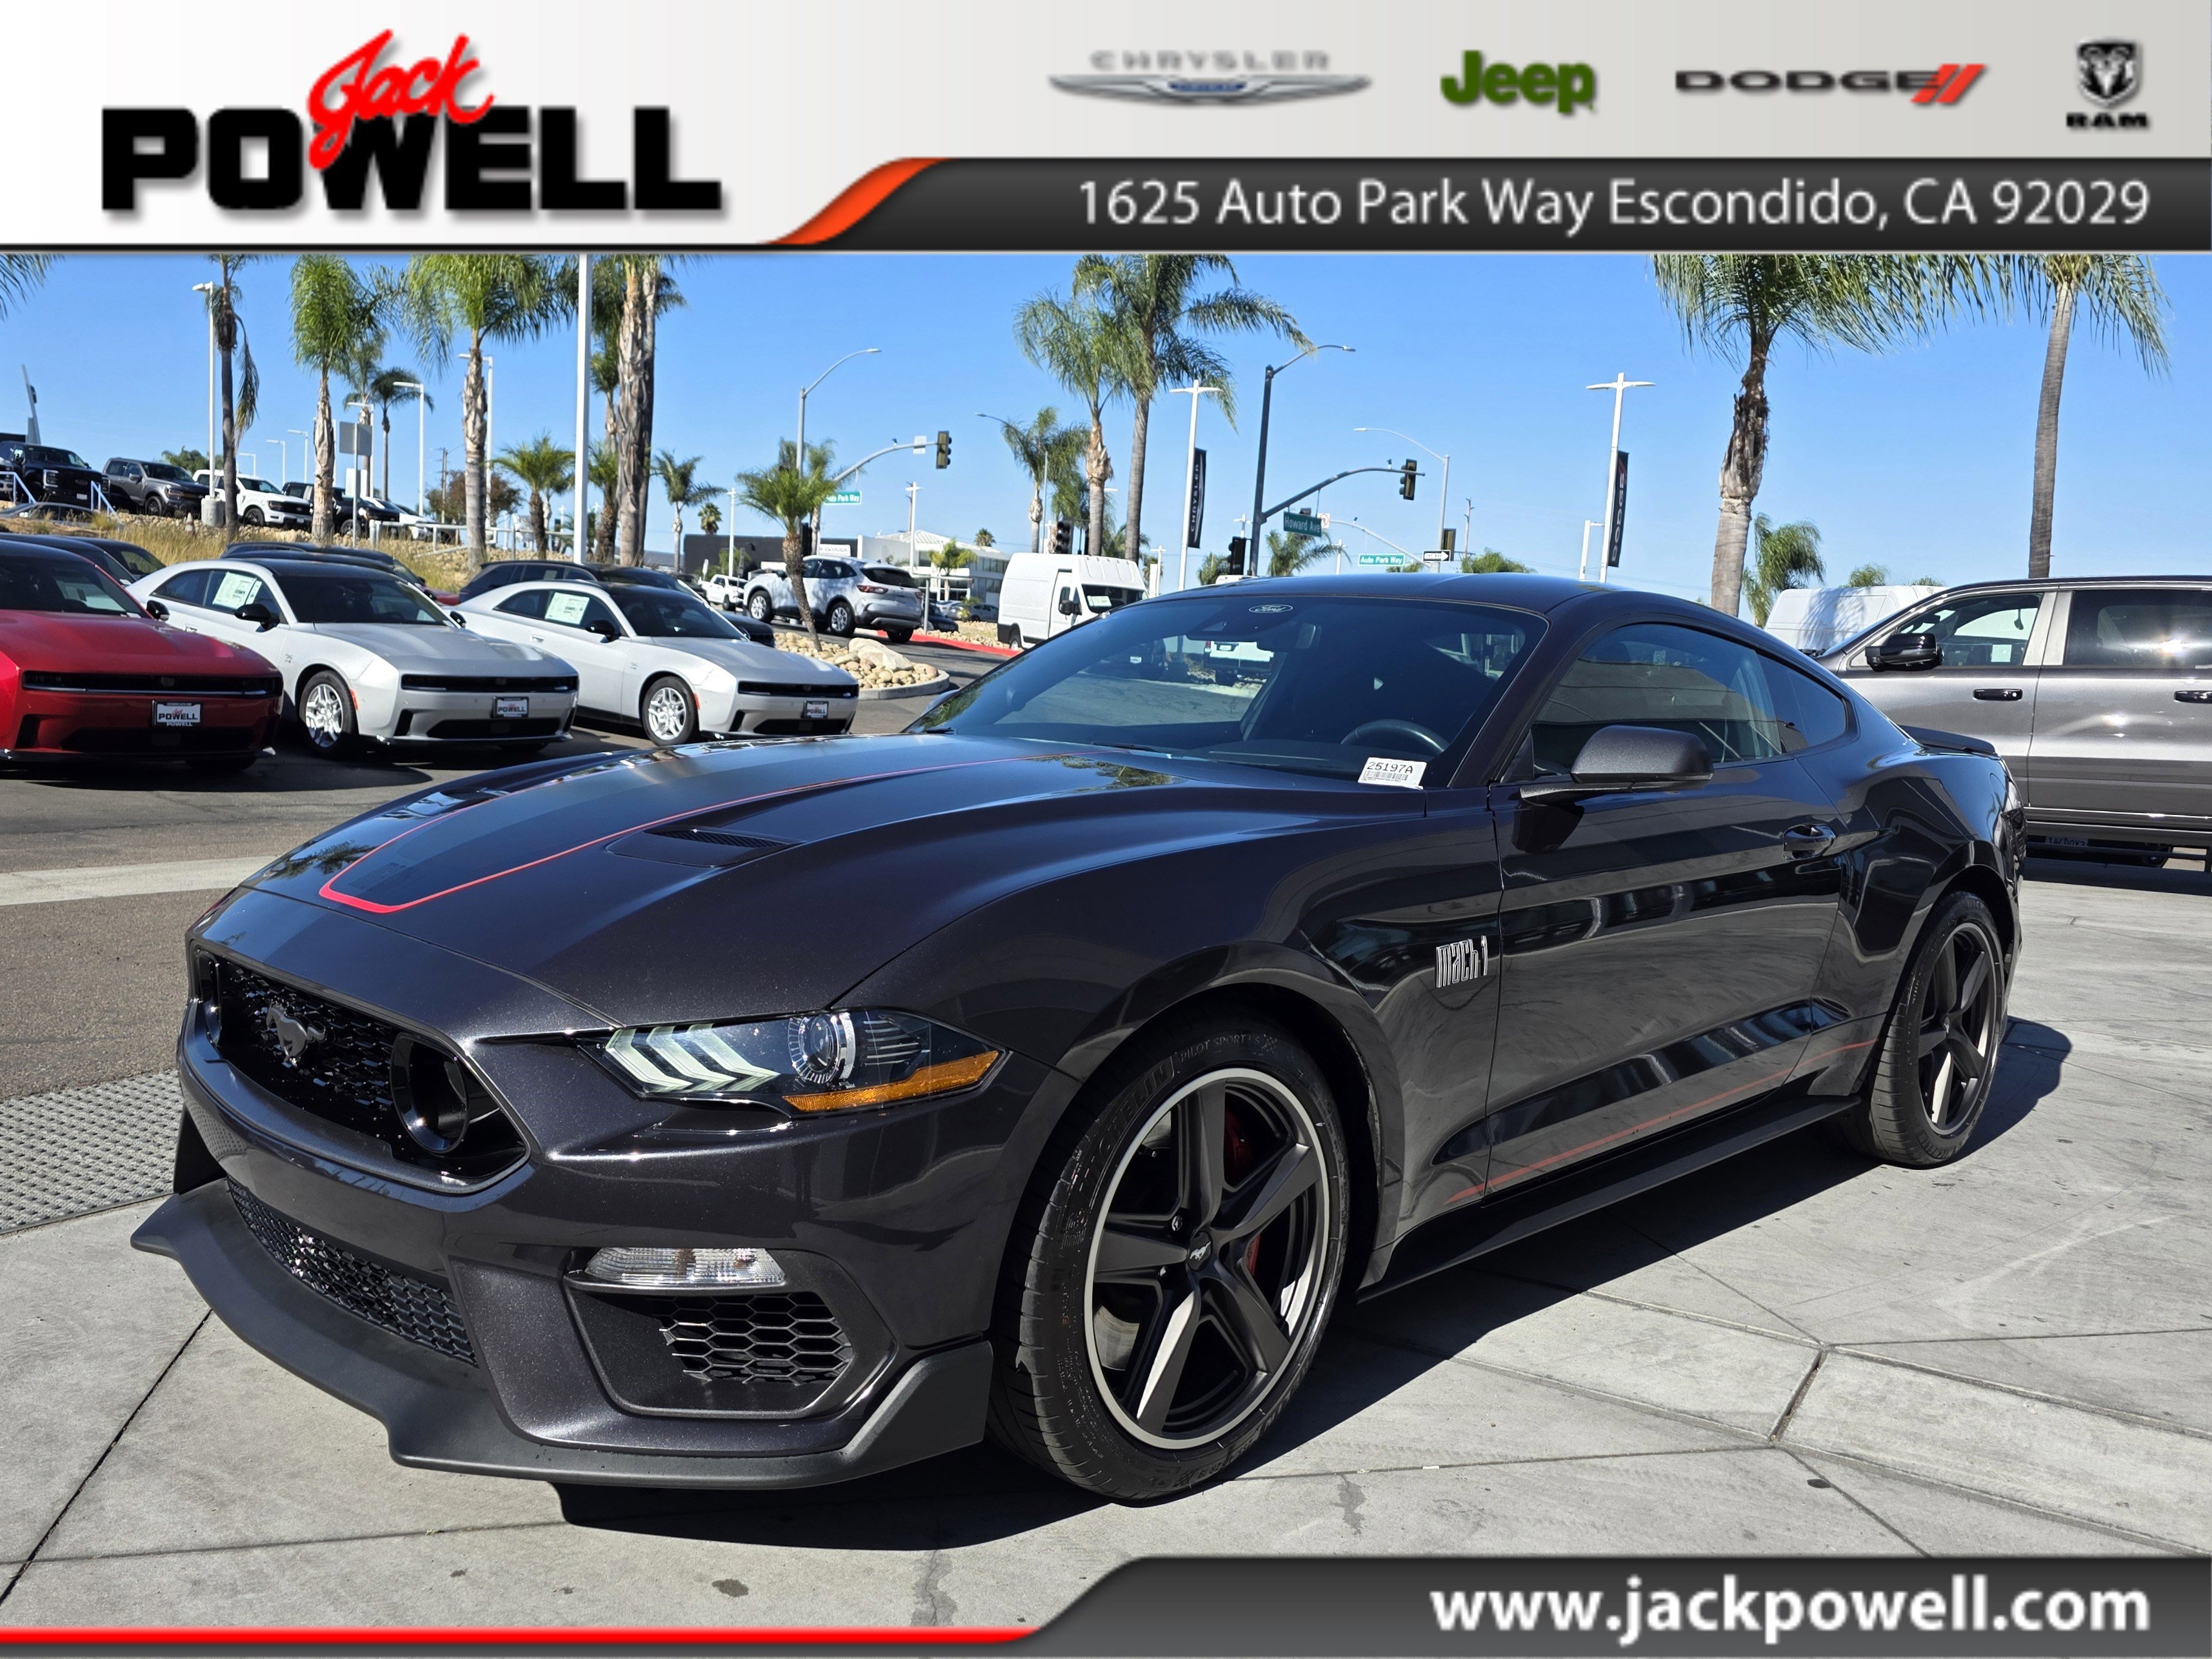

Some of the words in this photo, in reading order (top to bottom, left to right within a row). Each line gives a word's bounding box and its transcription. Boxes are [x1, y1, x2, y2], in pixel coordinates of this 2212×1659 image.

[1190, 464, 1199, 532] CHRYSLER
[1284, 516, 1308, 531] Howard
[1309, 521, 1320, 533] Ave
[1611, 472, 1624, 561] DODGE
[1390, 556, 1403, 565] Way
[1366, 761, 1414, 774] 25197A
[1480, 934, 1488, 976] 1
[1180, 1039, 1210, 1063] PILOT
[1213, 1033, 1246, 1046] SPORT
